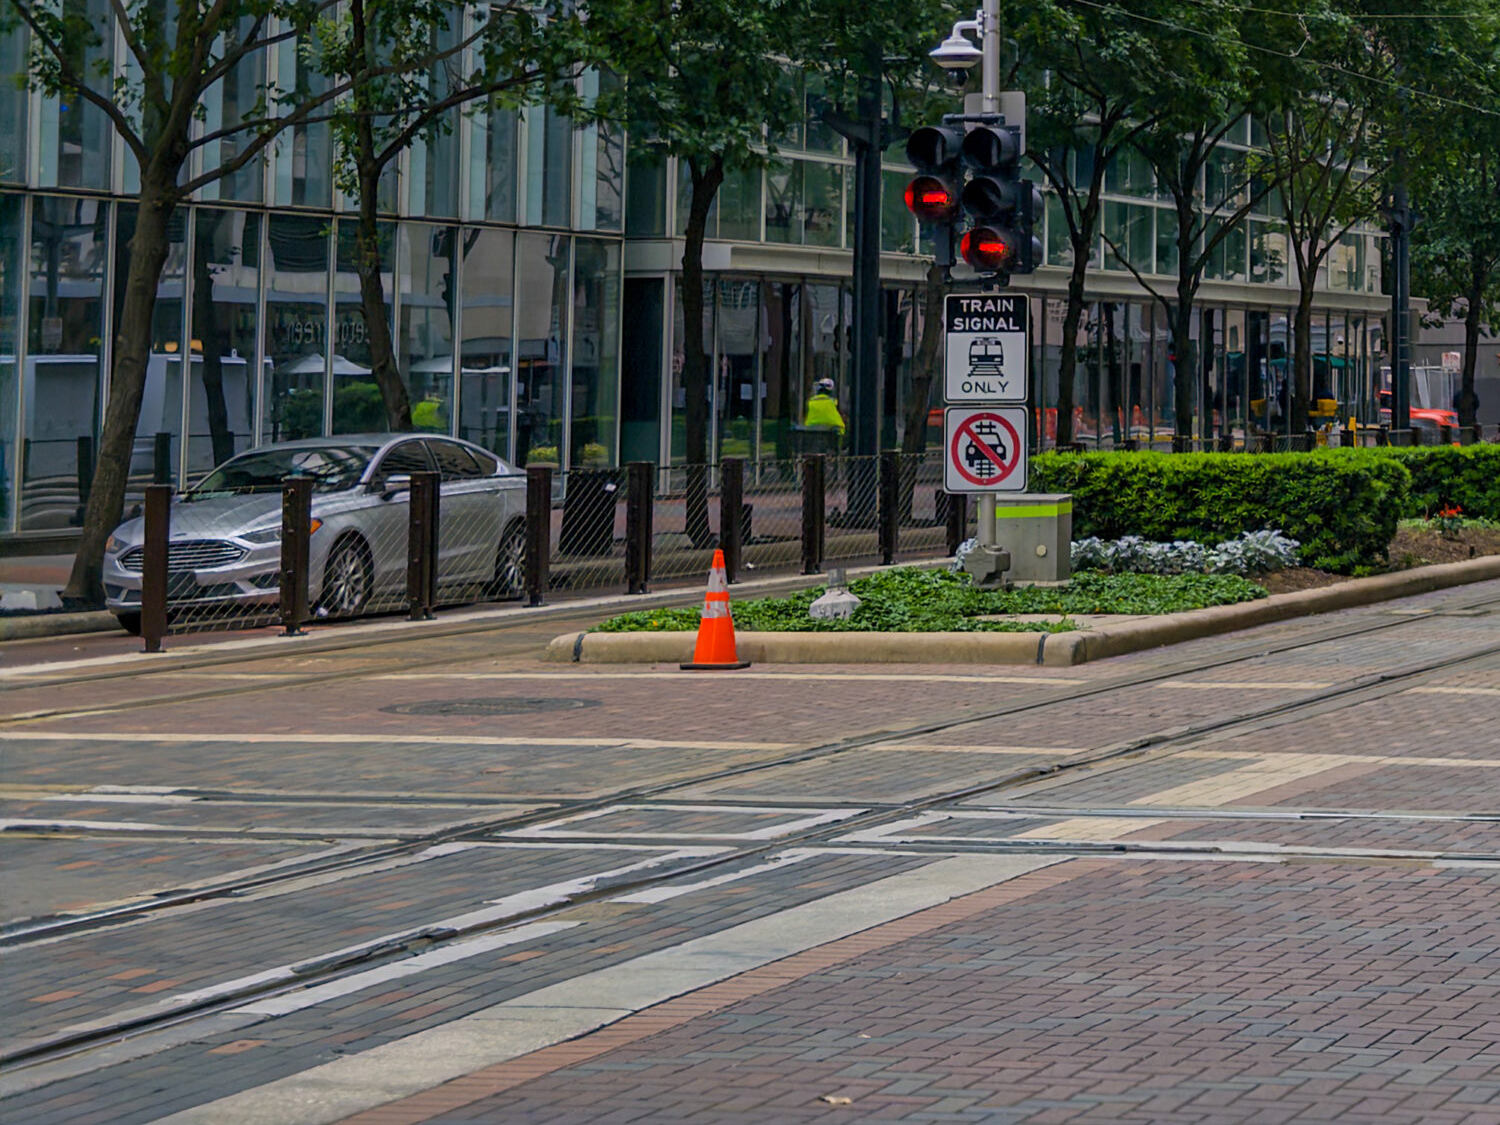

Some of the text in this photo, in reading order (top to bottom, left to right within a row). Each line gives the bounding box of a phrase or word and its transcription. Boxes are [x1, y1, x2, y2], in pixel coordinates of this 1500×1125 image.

[959, 299, 1014, 313] TRAIN
[953, 317, 1020, 331] SIGNAL
[961, 381, 1010, 394] ONLY
